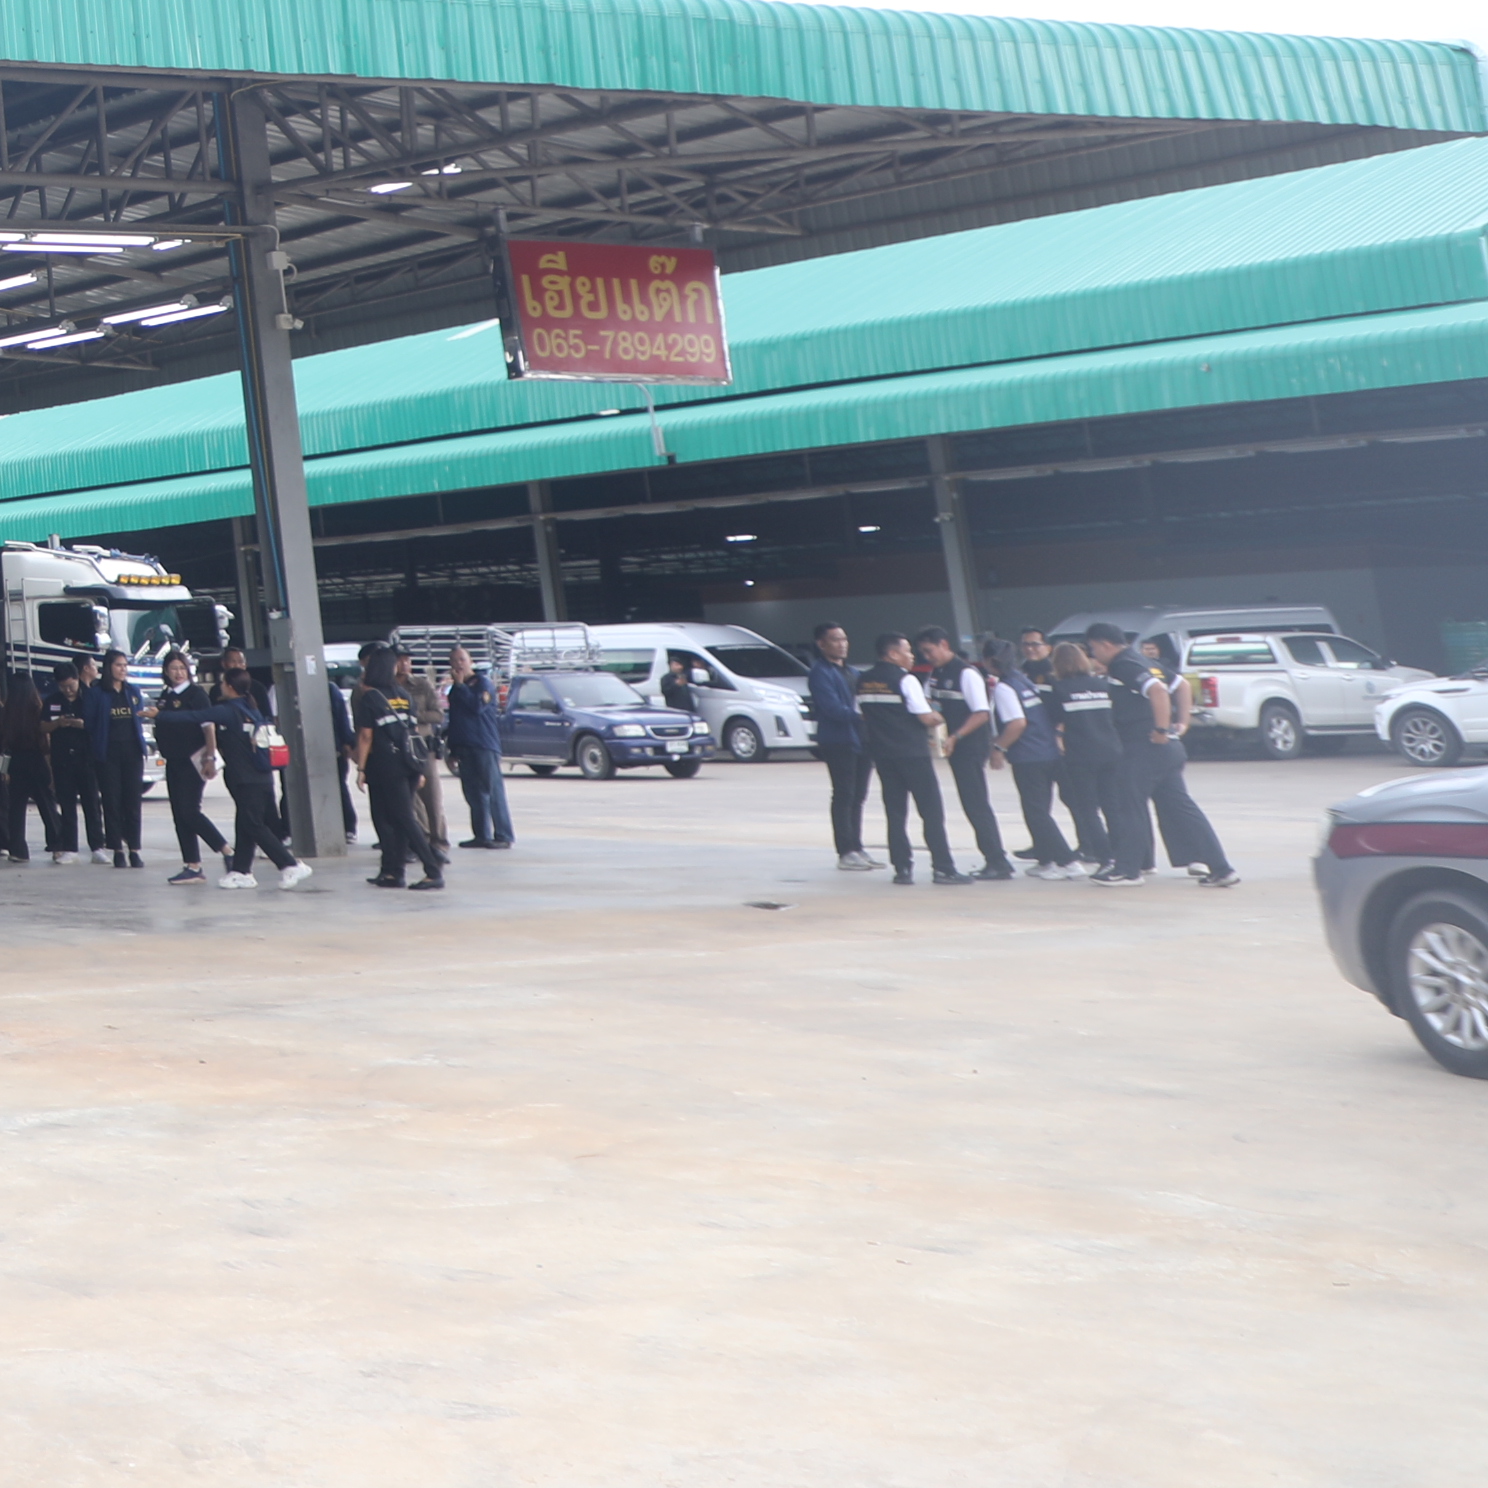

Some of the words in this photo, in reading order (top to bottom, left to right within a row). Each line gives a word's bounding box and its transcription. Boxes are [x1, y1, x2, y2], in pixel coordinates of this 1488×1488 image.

[520, 250, 715, 325] เฮียแต๊ก
[532, 327, 717, 364] 065-7894299
